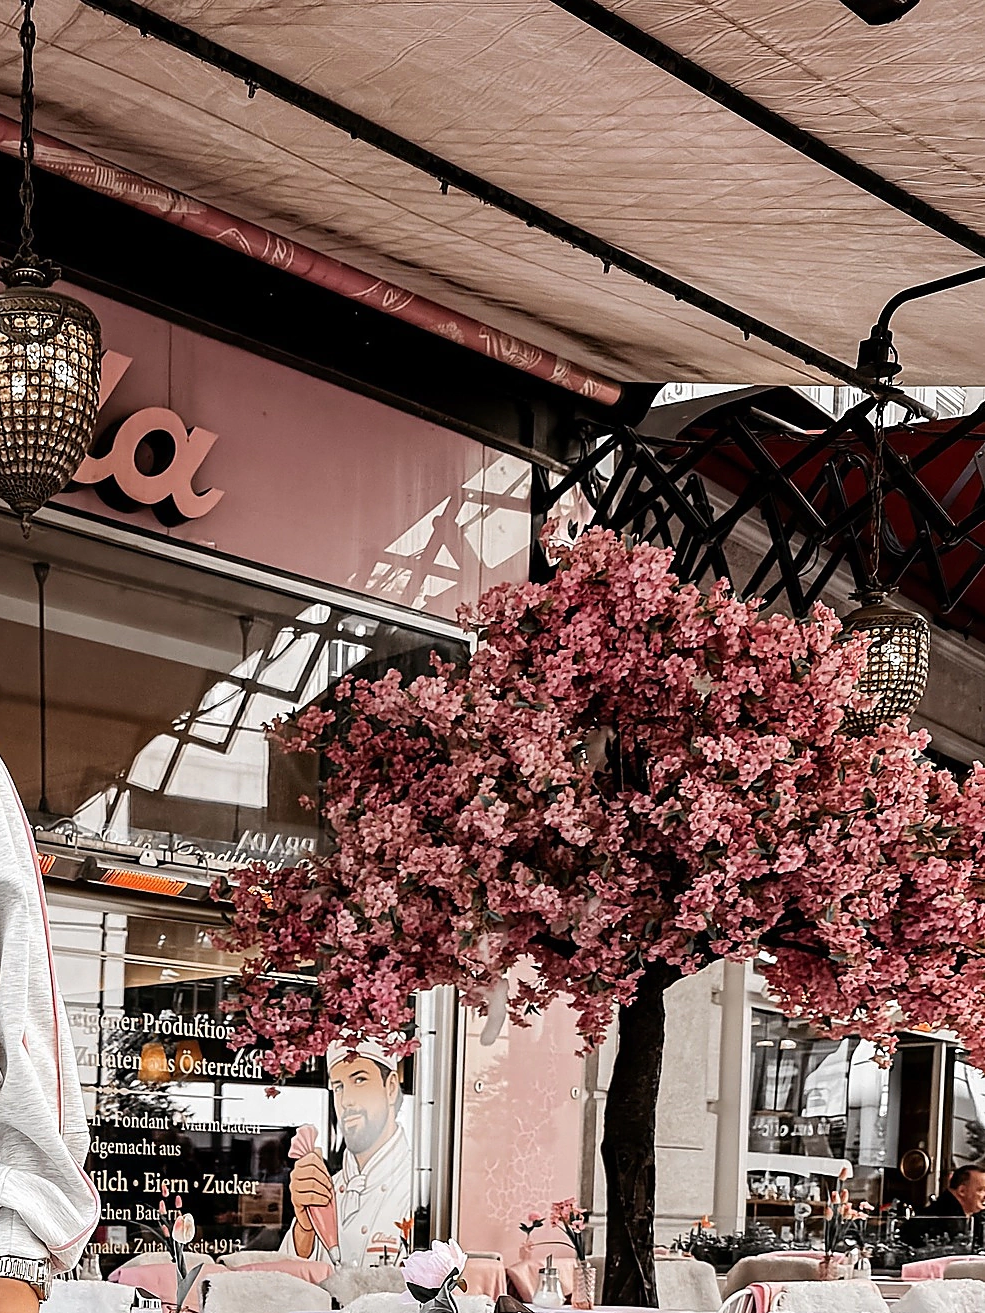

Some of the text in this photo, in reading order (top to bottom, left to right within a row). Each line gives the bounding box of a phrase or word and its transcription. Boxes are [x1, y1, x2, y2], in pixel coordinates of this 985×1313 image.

[142, 1012, 235, 1040] Produktion
[179, 1049, 263, 1079] Österreich
[114, 1111, 170, 1130] Fondant
[89, 1135, 182, 1159] dgemacht aus
[143, 1172, 189, 1193] Eiern
[202, 1173, 260, 1195] Zucker
[187, 1239, 209, 1254] seit
